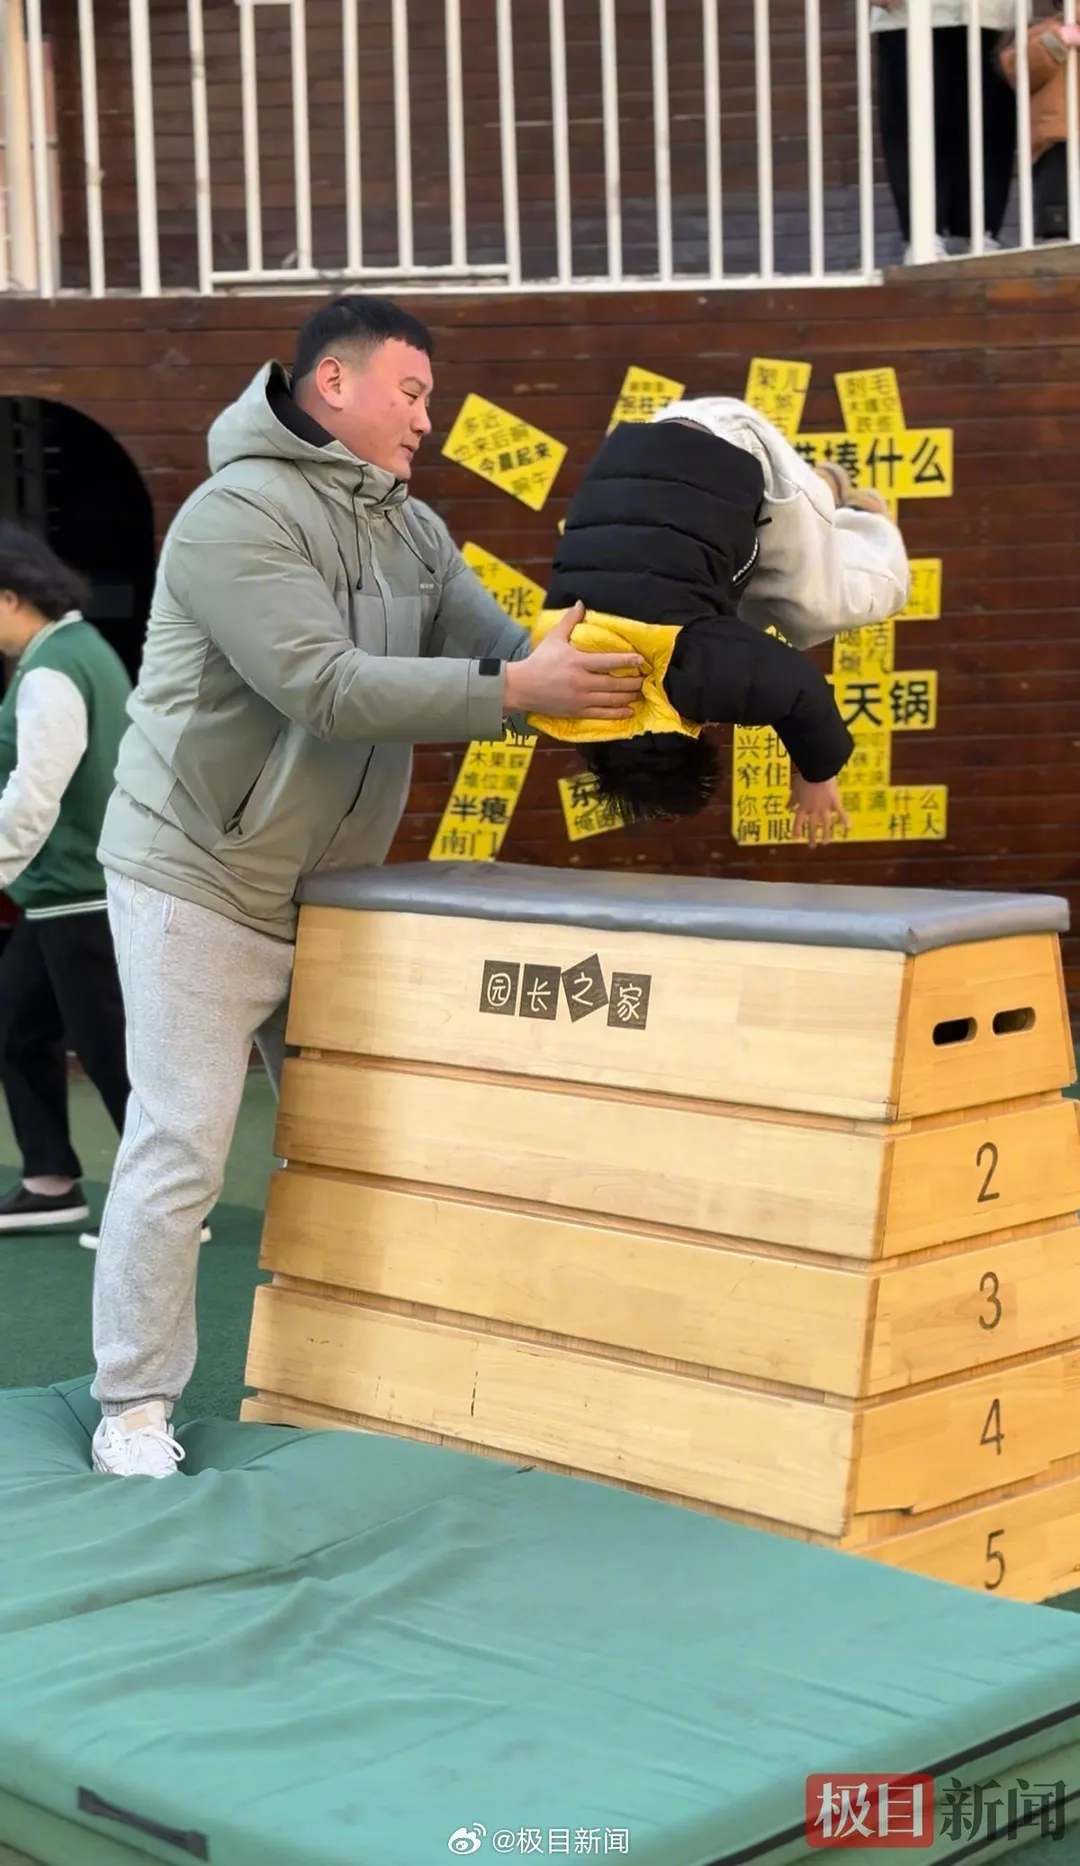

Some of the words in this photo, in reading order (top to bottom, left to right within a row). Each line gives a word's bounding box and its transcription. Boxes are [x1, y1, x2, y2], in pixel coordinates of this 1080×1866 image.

[843, 680, 929, 726] 天锅
[441, 827, 498, 858] 南门
[487, 971, 643, 1022] 园长之家
[976, 1141, 1000, 1202] 2
[978, 1271, 1002, 1330] 3
[979, 1398, 1005, 1456] 4
[983, 1529, 1006, 1590] 5
